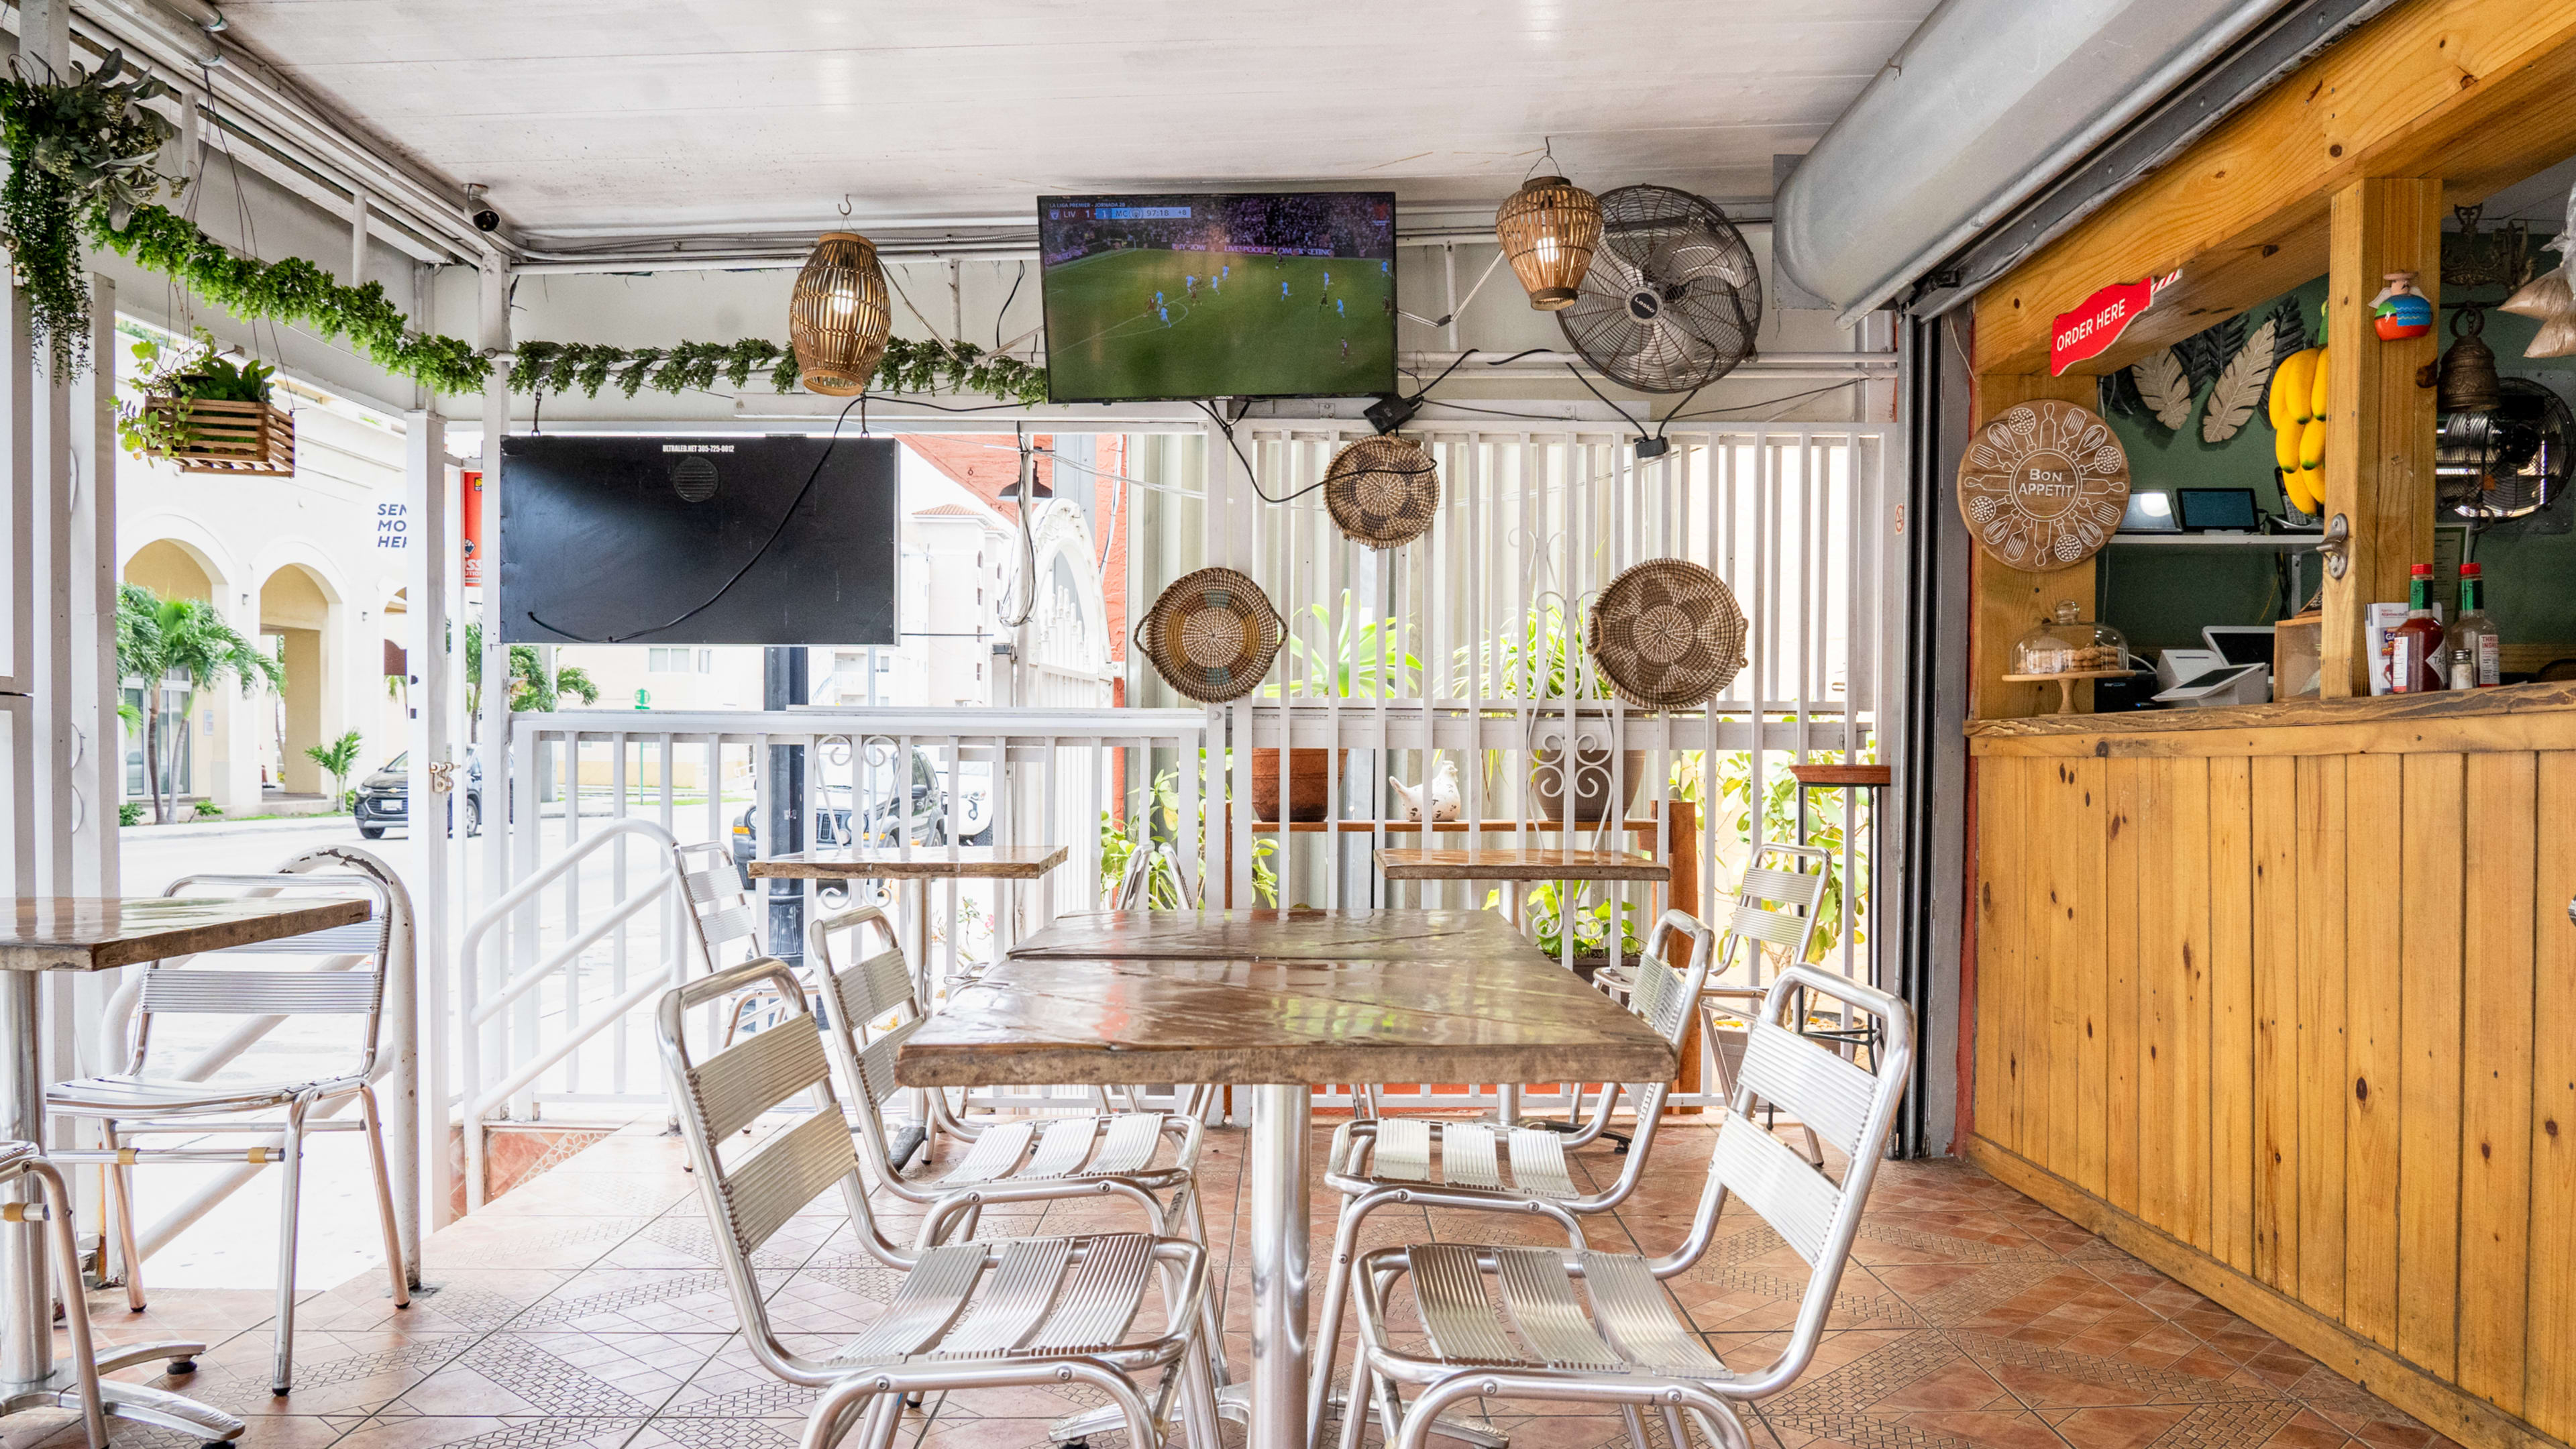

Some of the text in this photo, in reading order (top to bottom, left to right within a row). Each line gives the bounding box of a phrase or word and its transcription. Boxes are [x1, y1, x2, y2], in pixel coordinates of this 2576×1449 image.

[1085, 210, 1090, 219] 1
[1102, 210, 1107, 218] 1
[1634, 297, 1656, 313] Lasko
[2056, 298, 2126, 352] ORDER HERE
[377, 520, 407, 532] MO
[465, 559, 482, 571] SS
